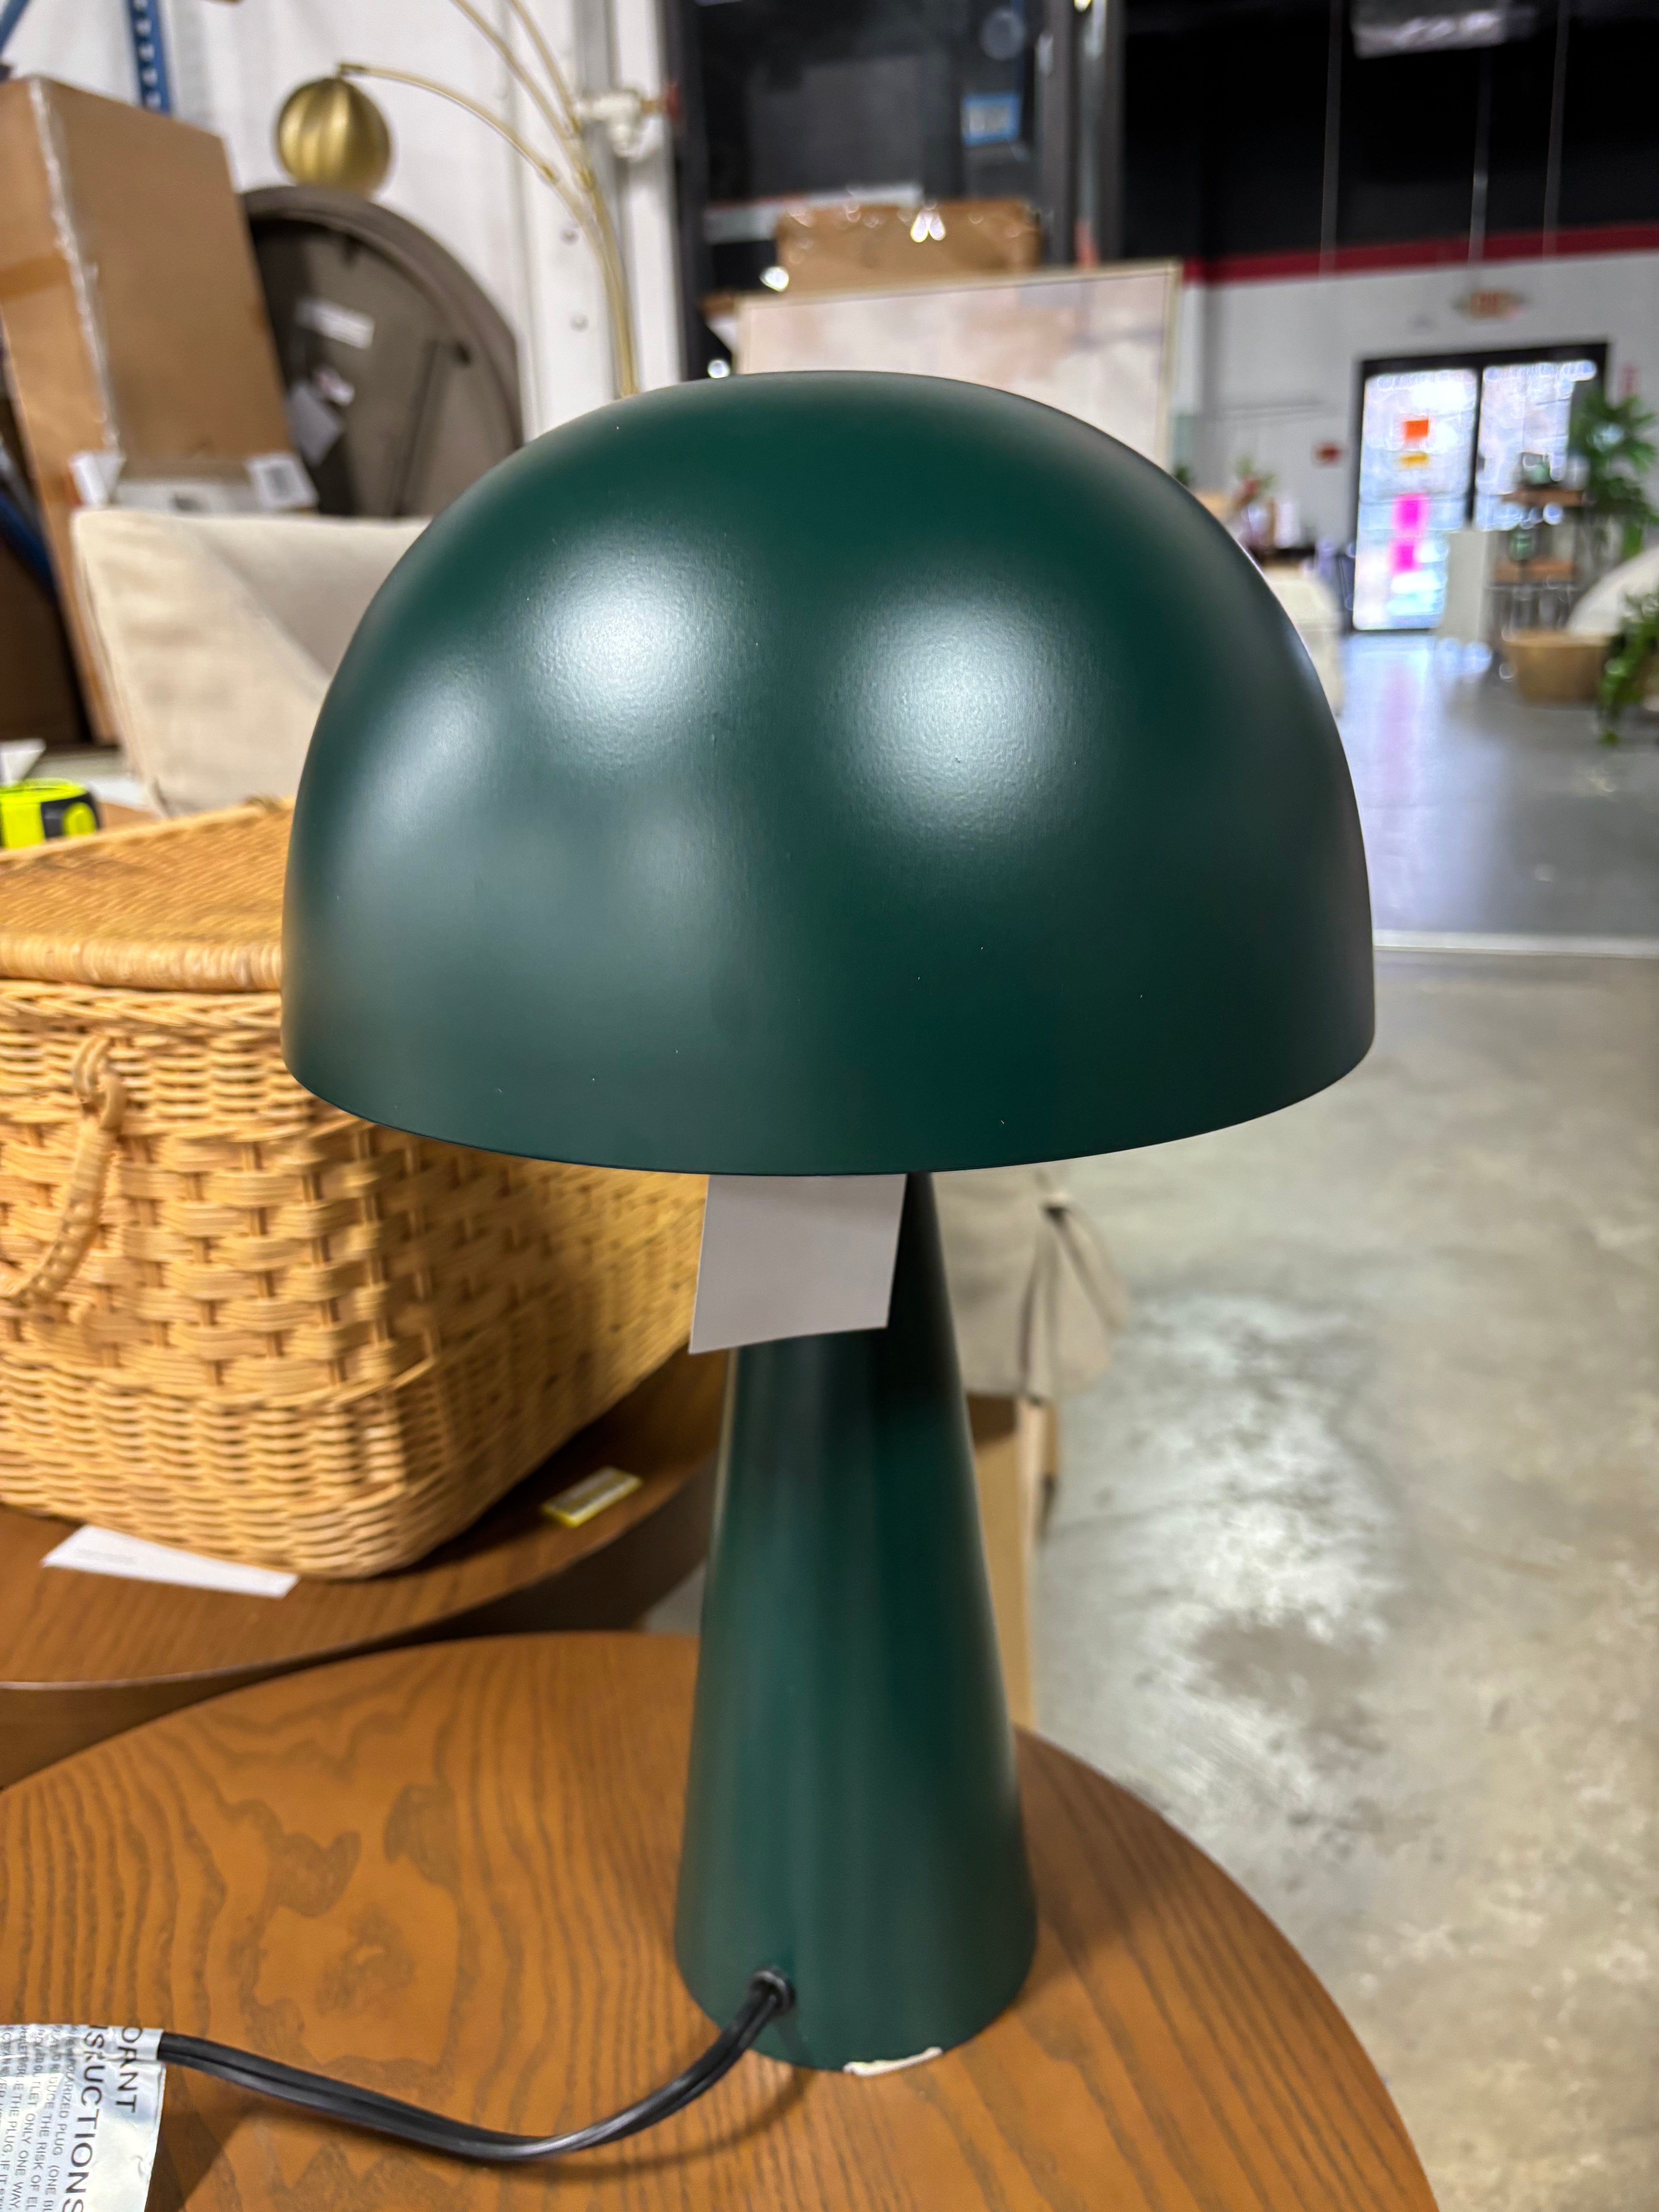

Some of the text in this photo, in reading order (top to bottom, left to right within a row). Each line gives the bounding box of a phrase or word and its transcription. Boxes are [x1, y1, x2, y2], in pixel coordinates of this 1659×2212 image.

[9, 2094, 23, 2117] THE
[21, 2113, 36, 2144] ONLY
[40, 2114, 52, 2137] THE
[52, 2123, 66, 2155] PLUG
[15, 2150, 29, 2176] ONE
[33, 2142, 47, 2170] RISK
[31, 2175, 41, 2191] OF
[45, 2165, 61, 2195] (ONE
